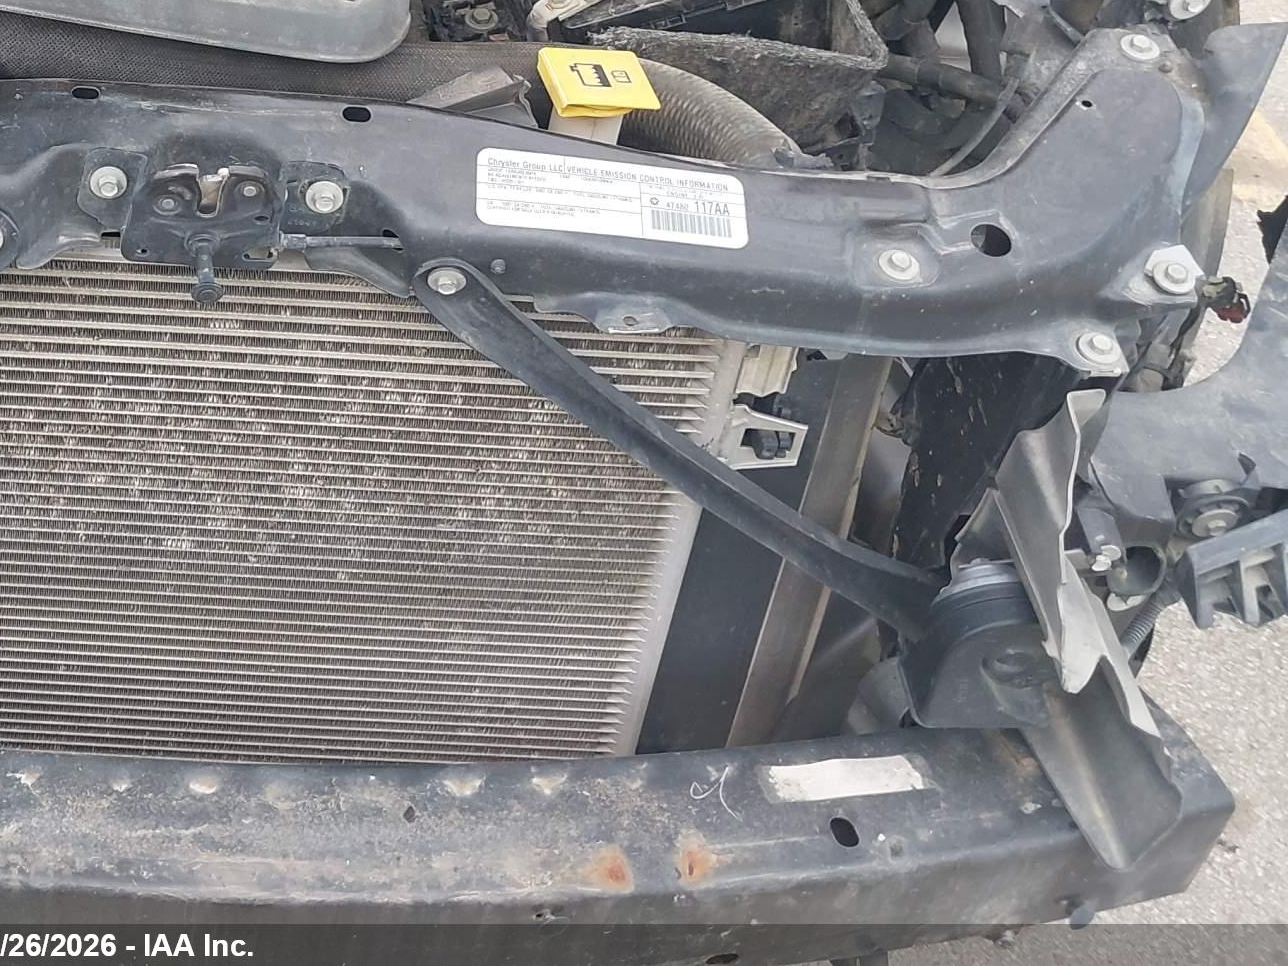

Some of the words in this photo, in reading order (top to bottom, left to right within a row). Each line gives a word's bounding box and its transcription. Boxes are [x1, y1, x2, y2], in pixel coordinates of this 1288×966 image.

[487, 157, 520, 171] Chrysler
[522, 160, 547, 173] Group
[548, 163, 563, 173] LLC
[566, 165, 598, 177] VEHICLE
[600, 169, 637, 181] EMISSION
[639, 174, 674, 187] CONTROL
[677, 178, 729, 192] INFORMATION
[694, 200, 730, 216] 117AA
